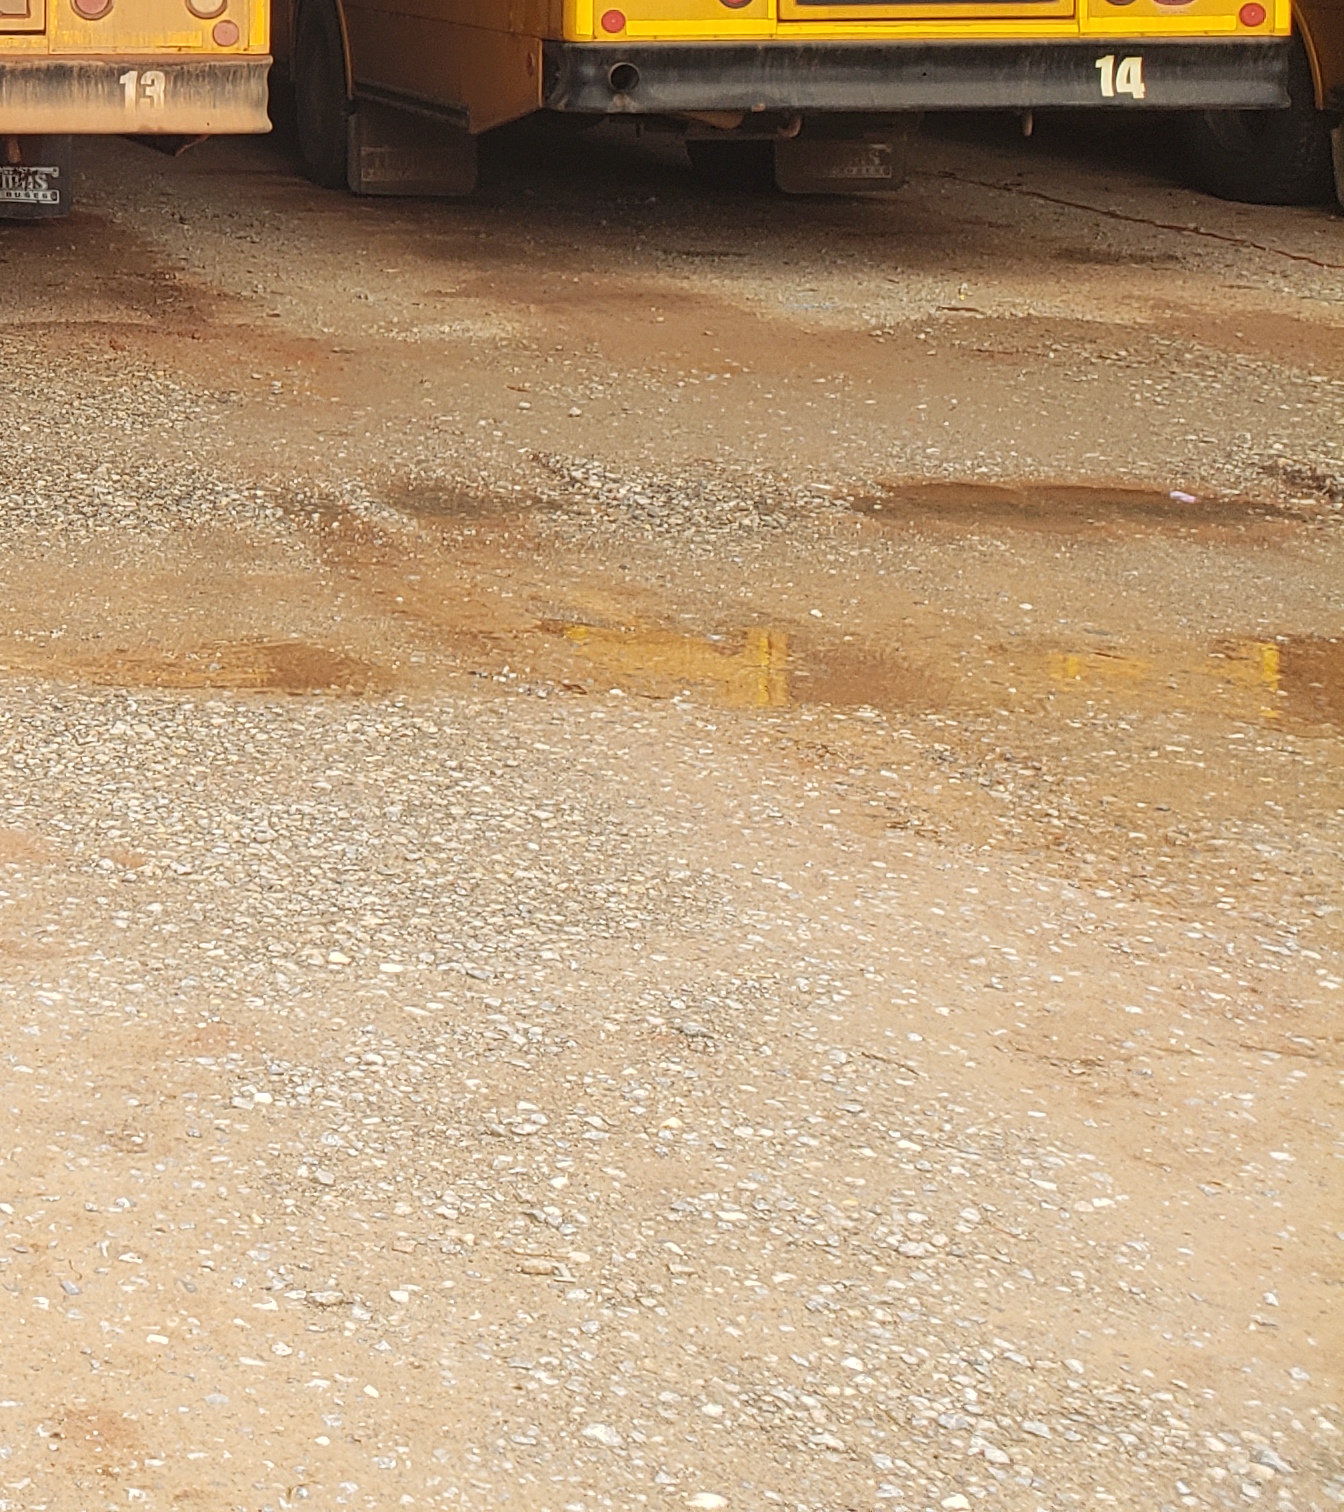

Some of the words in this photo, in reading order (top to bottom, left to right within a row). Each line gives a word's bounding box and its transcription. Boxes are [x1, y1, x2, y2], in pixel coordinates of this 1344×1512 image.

[119, 70, 165, 110] 13
[1095, 55, 1146, 99] 14
[5, 191, 50, 199] BUSES
